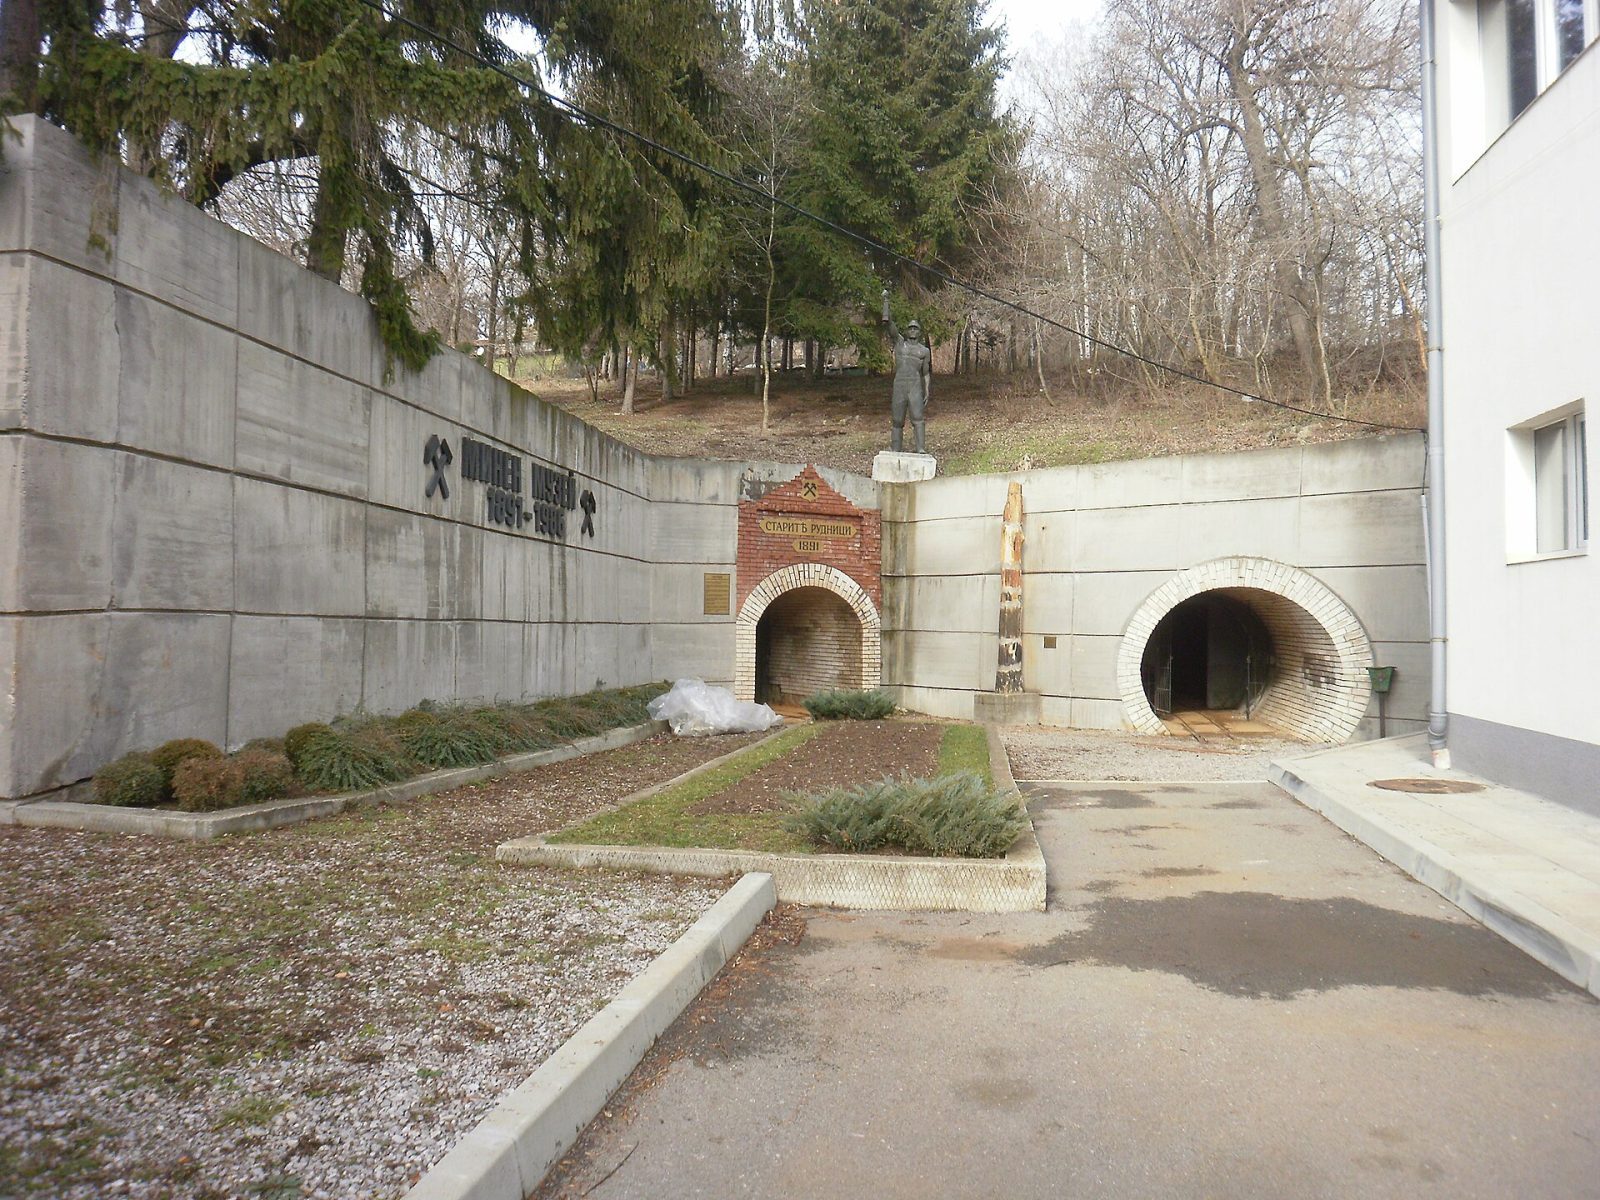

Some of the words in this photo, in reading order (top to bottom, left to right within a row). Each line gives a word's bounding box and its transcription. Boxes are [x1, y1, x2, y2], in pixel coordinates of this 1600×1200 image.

[461, 437, 522, 493] МИНЕН
[531, 463, 576, 511] МУЗЕЙ
[811, 524, 851, 535] РУДНИЦИ
[799, 541, 818, 550] 1891
